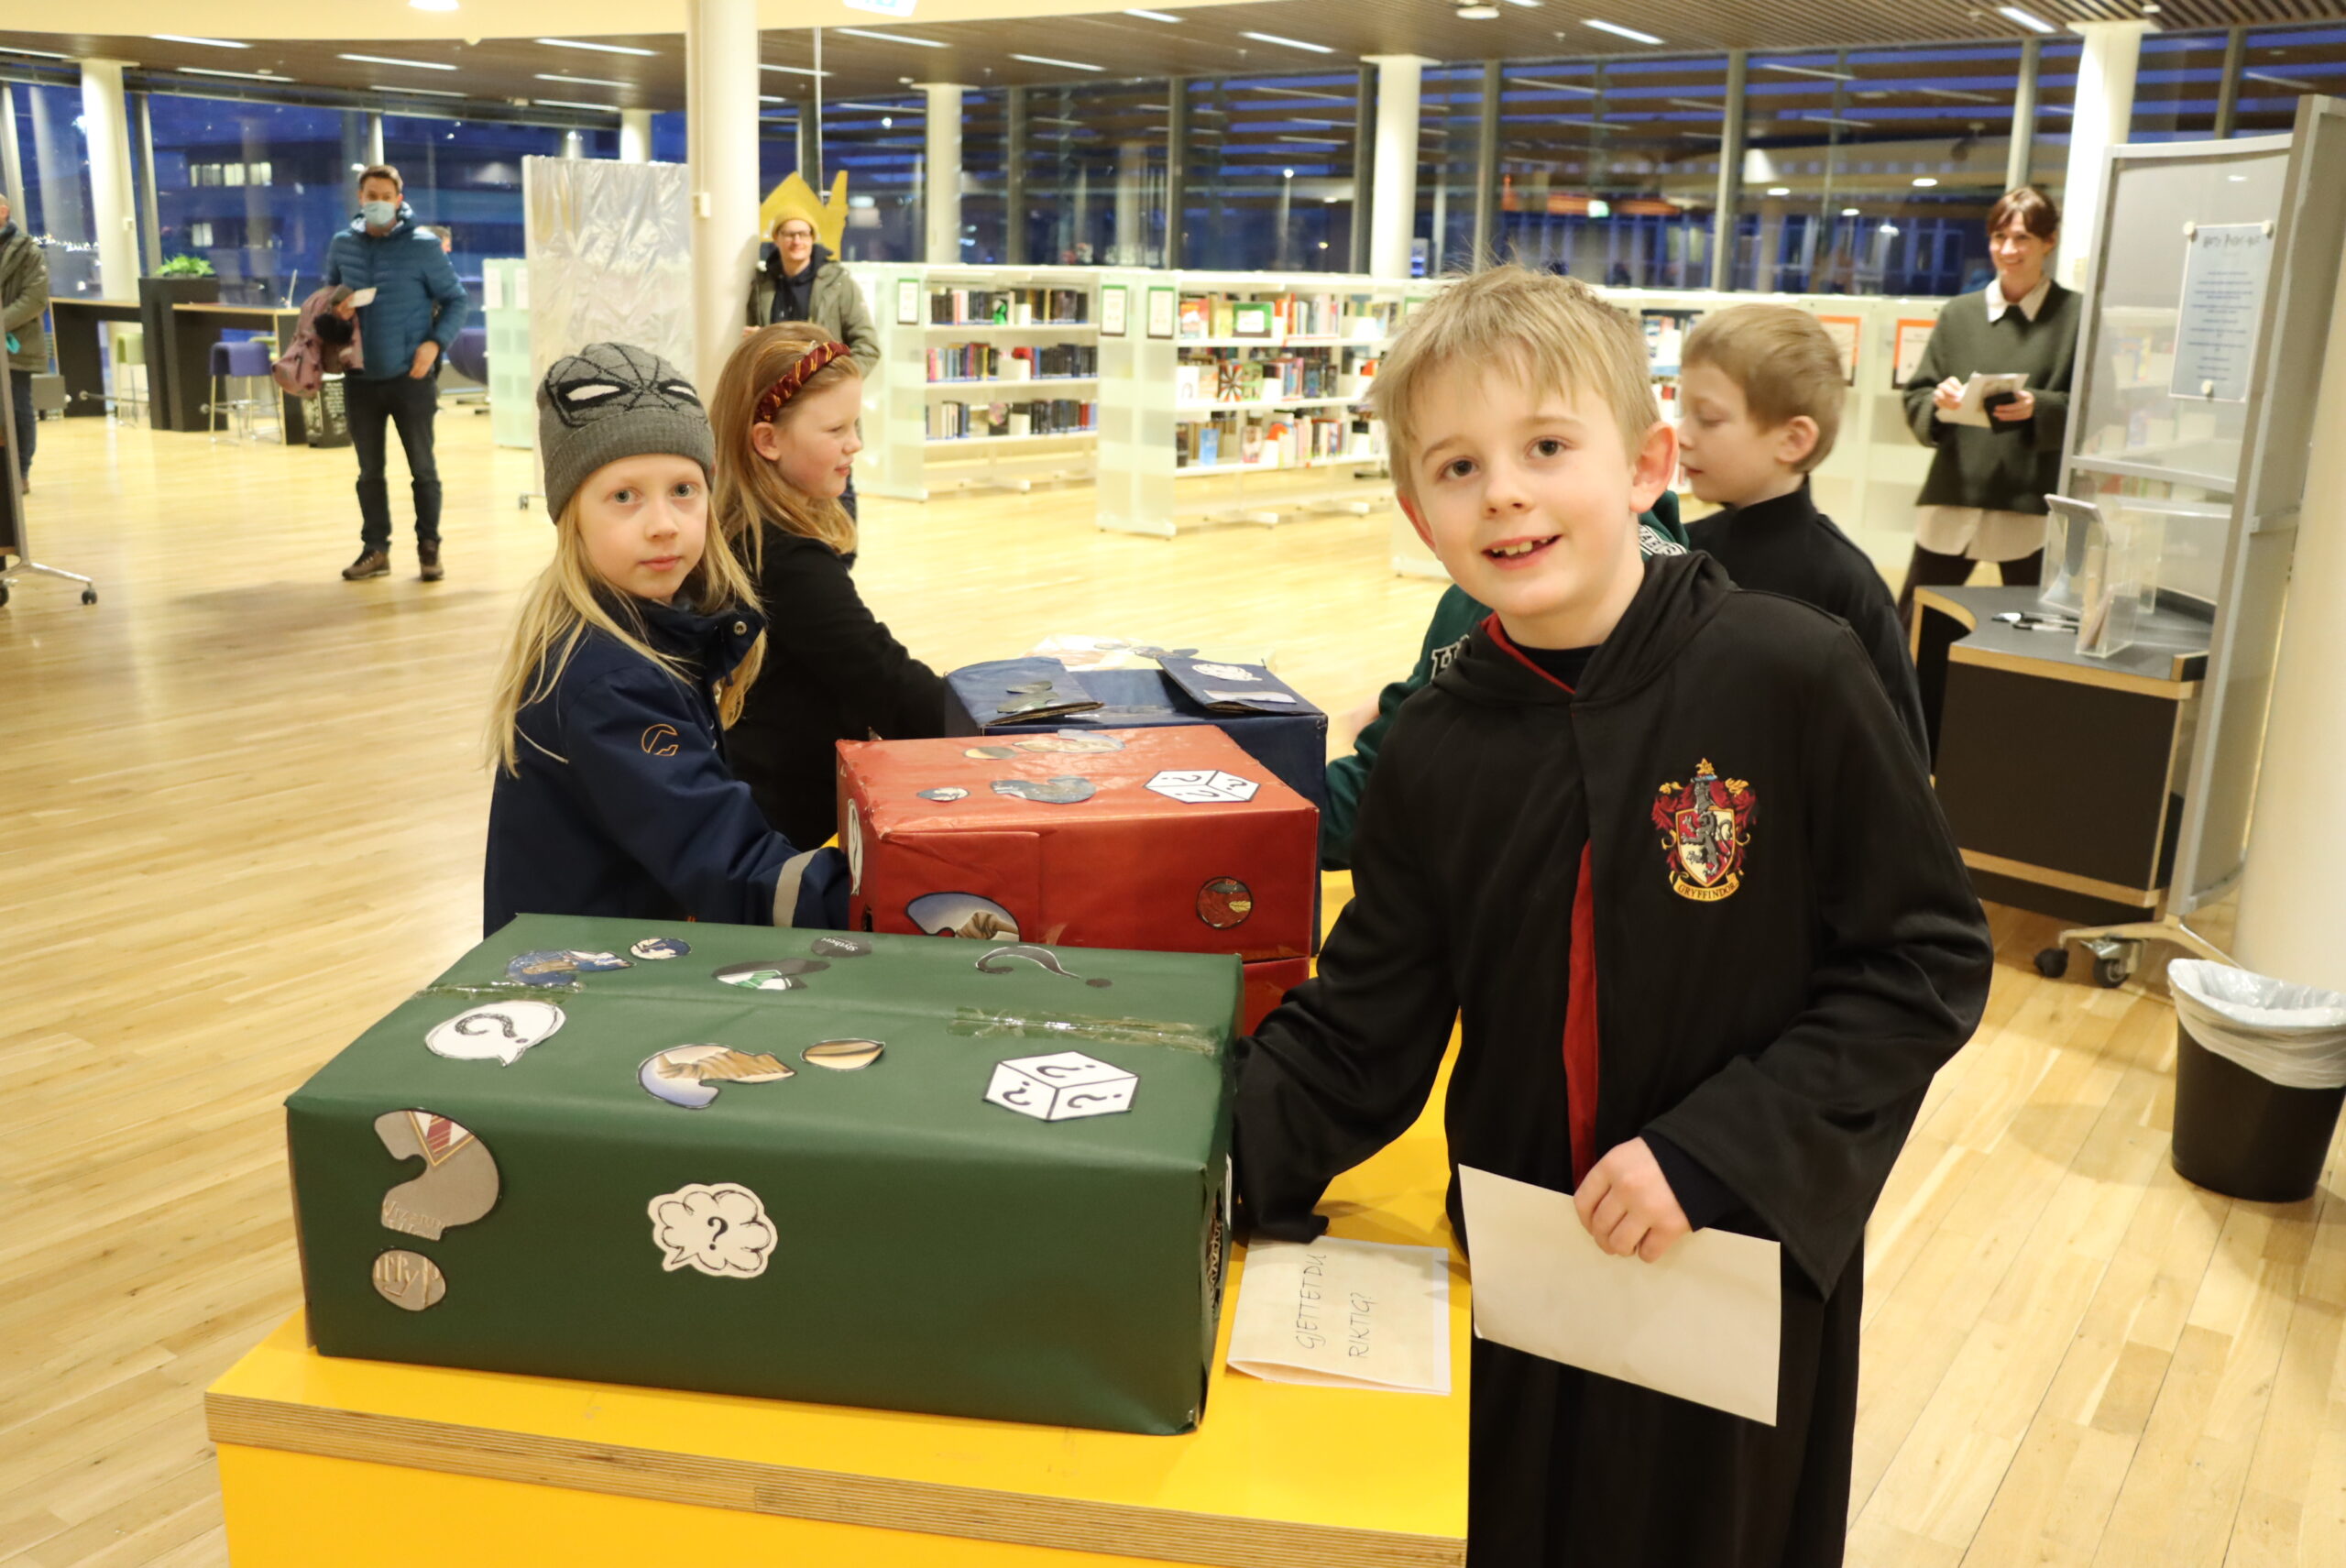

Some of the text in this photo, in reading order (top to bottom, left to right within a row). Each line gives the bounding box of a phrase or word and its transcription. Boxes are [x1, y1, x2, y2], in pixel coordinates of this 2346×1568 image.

[1678, 883, 1738, 899] GRYFFINDOR
[1295, 1277, 1327, 1350] GJETTET
[1348, 1291, 1378, 1358] RIKTIG?
